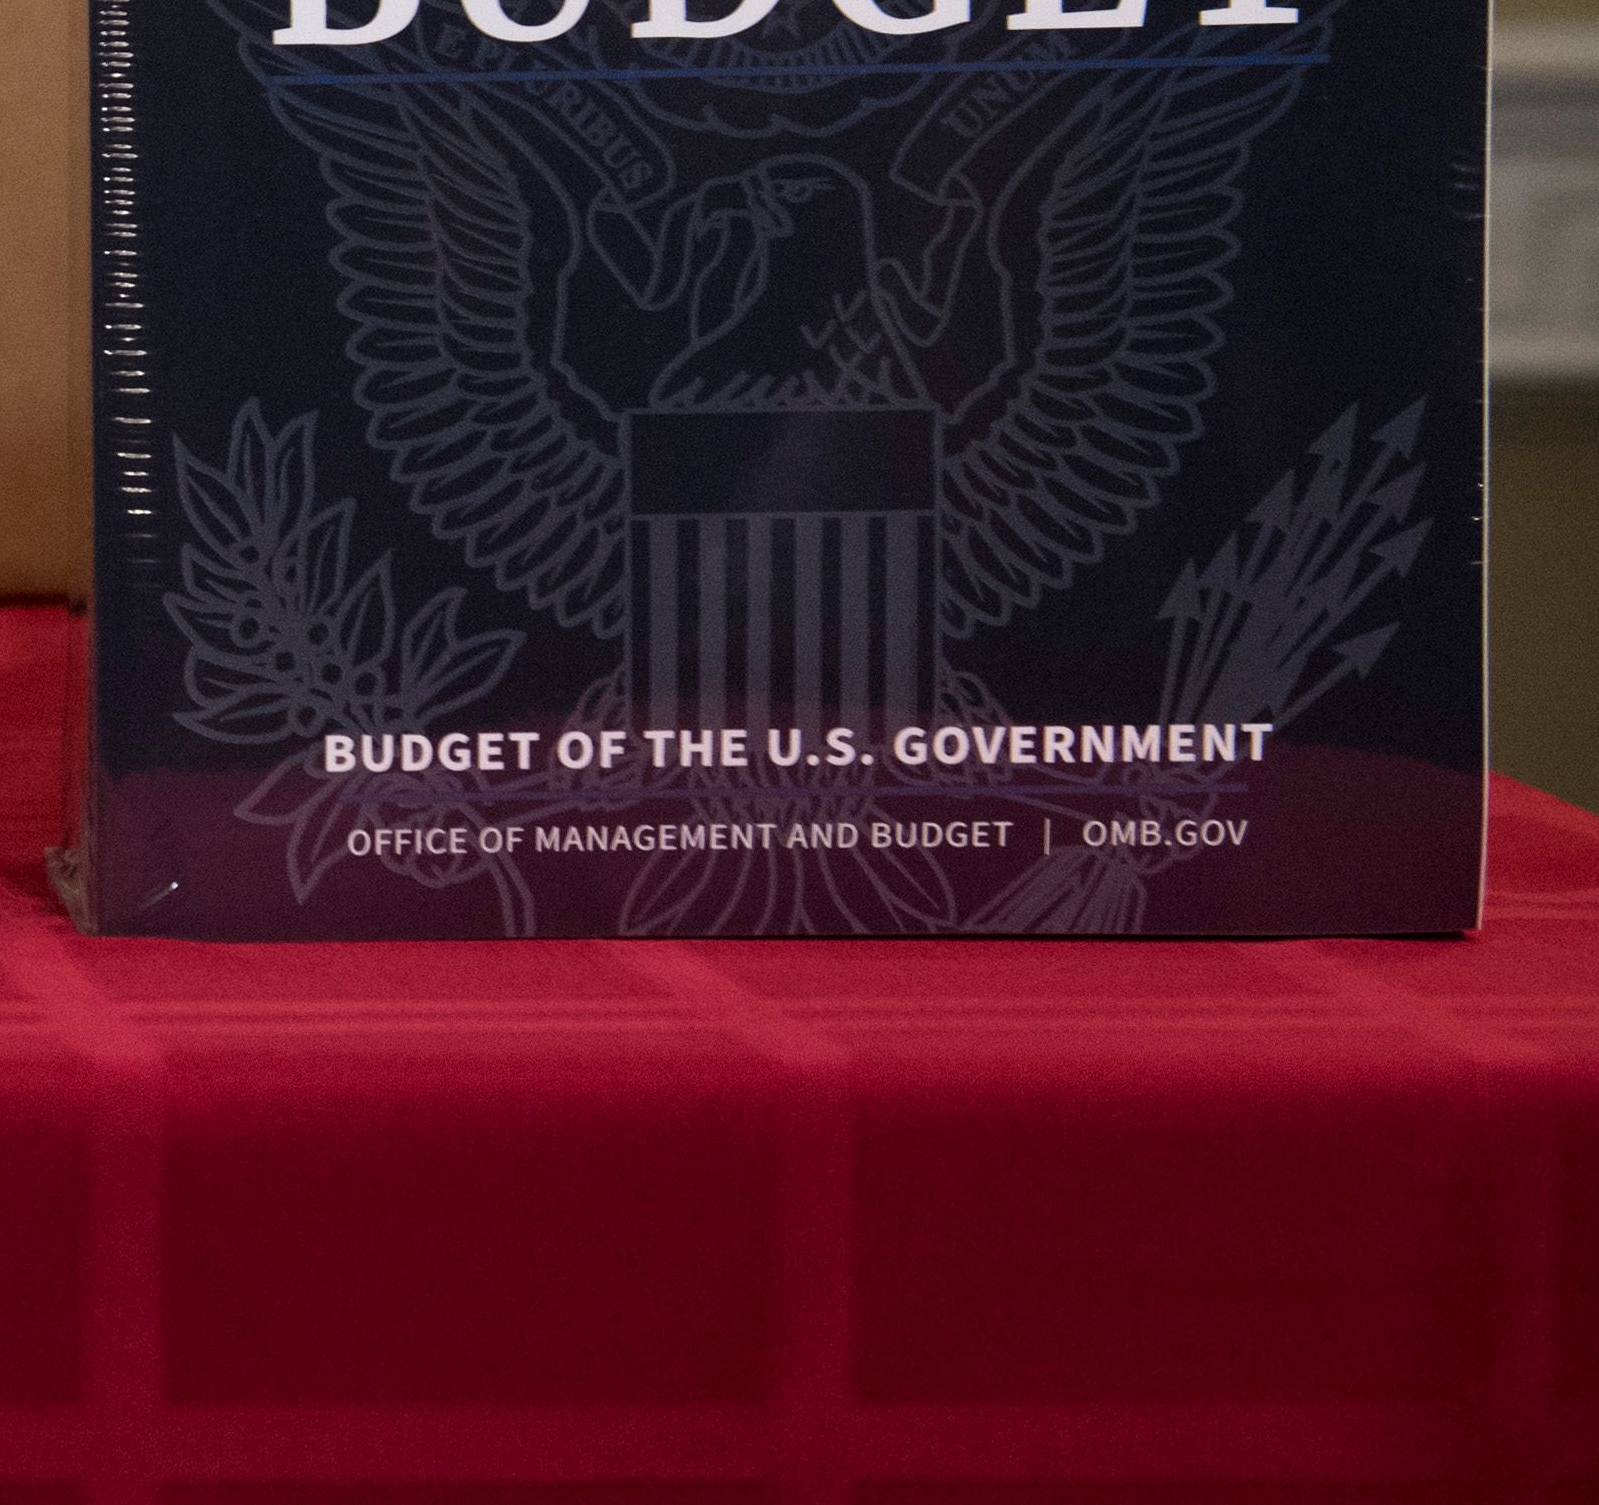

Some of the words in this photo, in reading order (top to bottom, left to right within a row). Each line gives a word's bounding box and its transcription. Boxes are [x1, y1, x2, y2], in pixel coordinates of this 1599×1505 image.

[325, 732, 539, 772] BUDGET
[558, 731, 626, 769] OF
[644, 730, 747, 767] THE
[768, 728, 873, 766] U.S.
[894, 724, 1273, 765] GOVERNMENT
[347, 828, 467, 856] OFFICE
[479, 827, 524, 853] OF
[536, 823, 777, 852] MANAGEMENT
[787, 823, 858, 848] AND
[871, 821, 1013, 848] BUDGET
[1083, 820, 1248, 846] OMB.GOV
